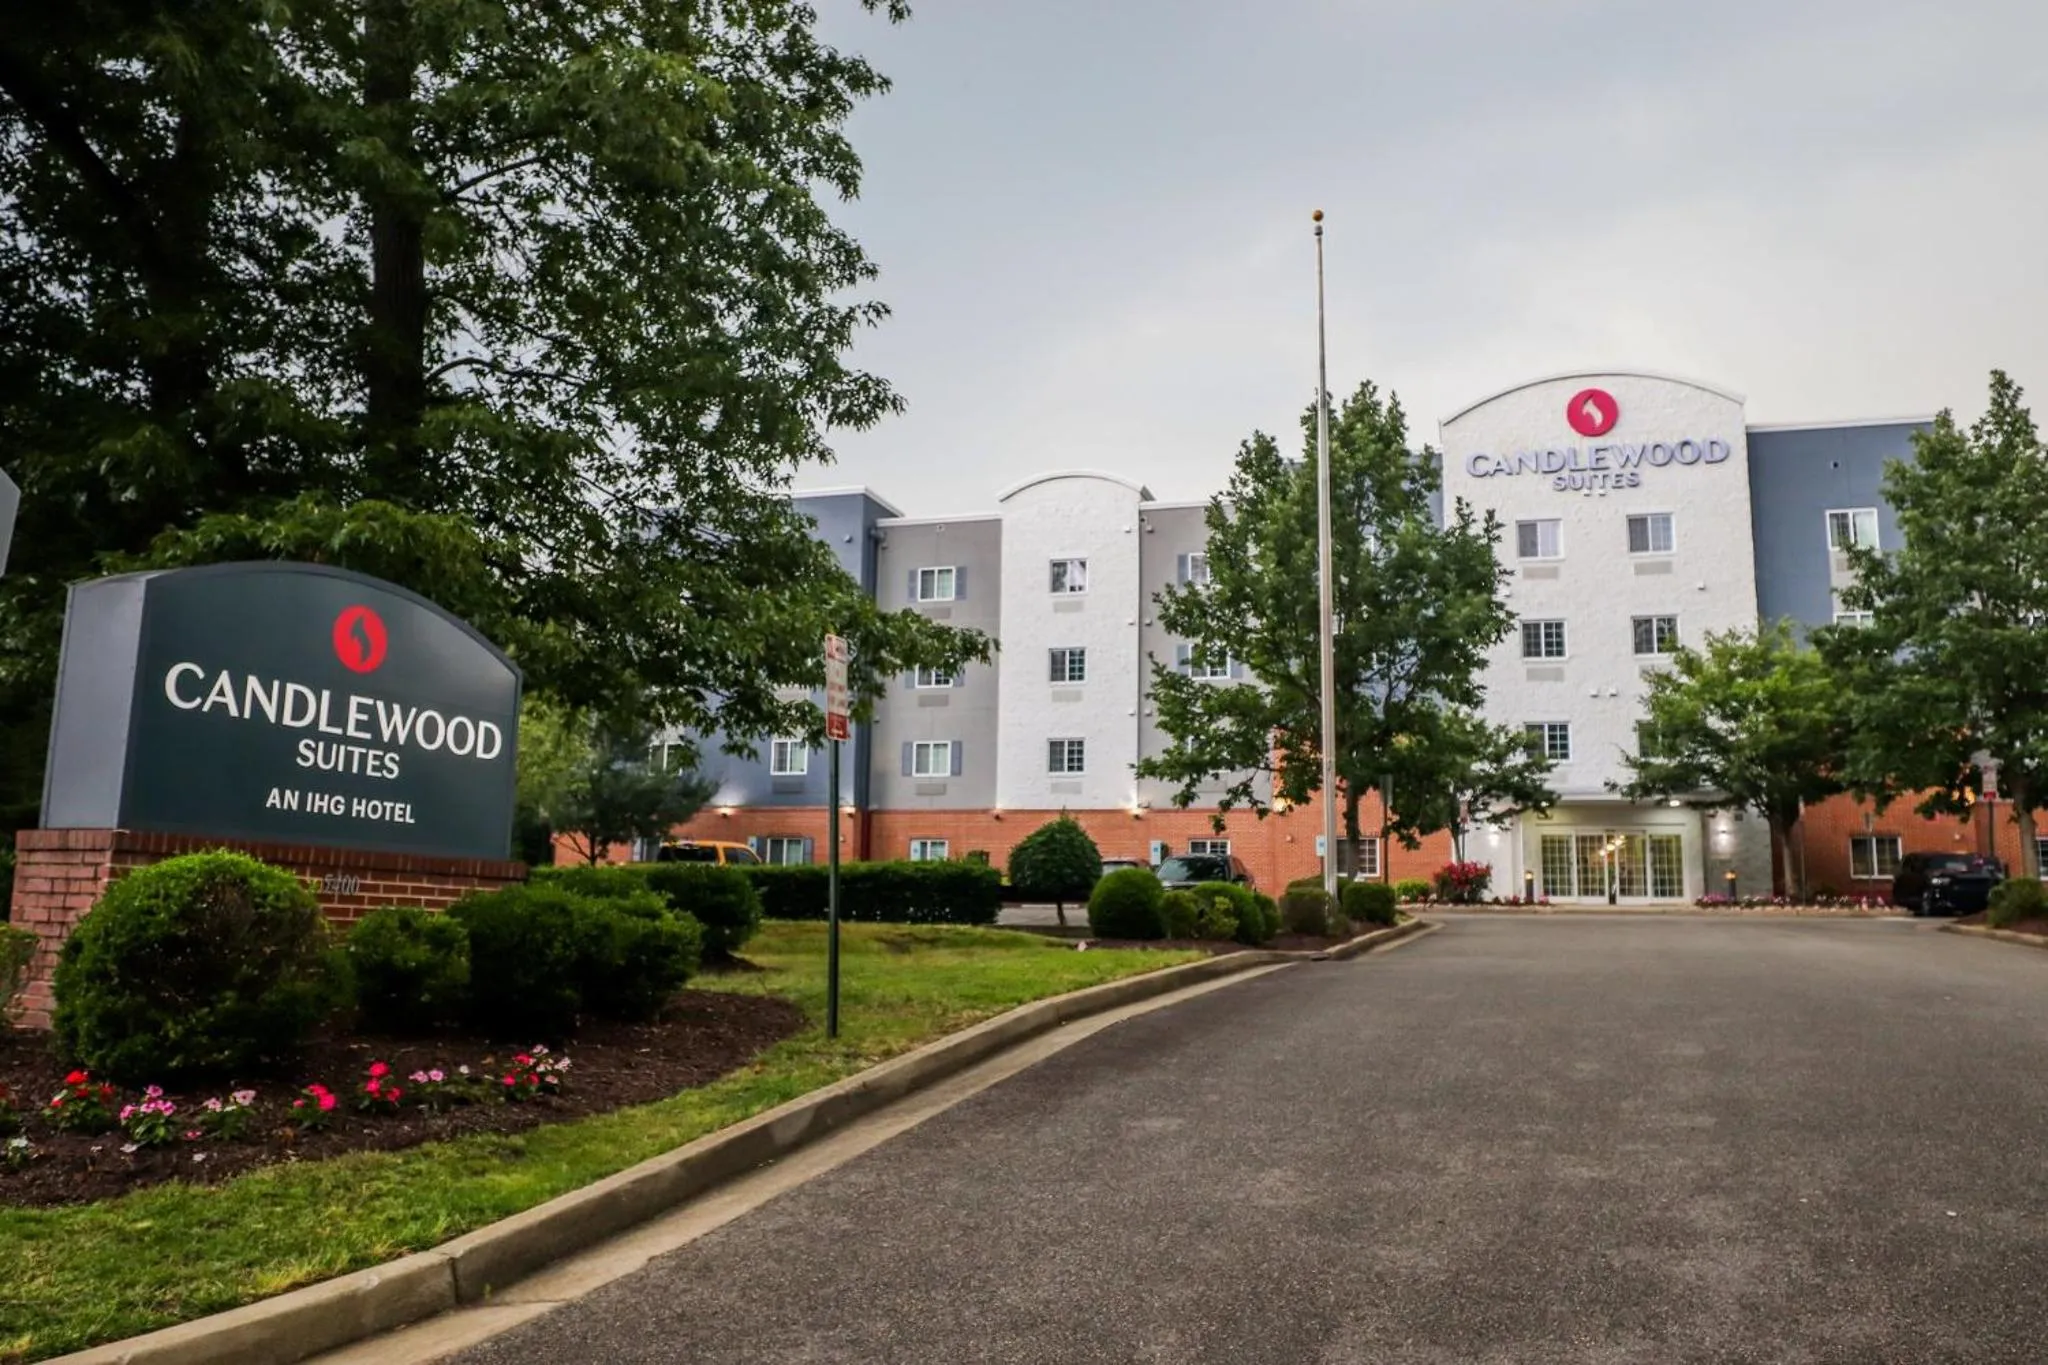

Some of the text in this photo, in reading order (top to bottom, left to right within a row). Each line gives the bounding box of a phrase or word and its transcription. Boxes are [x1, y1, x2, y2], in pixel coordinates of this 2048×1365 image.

[1465, 437, 1730, 478] CANDLEWOOD
[1553, 472, 1641, 491] SUITES
[164, 662, 502, 760] CANDLEWOOD
[296, 738, 400, 780] SUITES
[265, 787, 416, 824] AN IHG HOTEL
